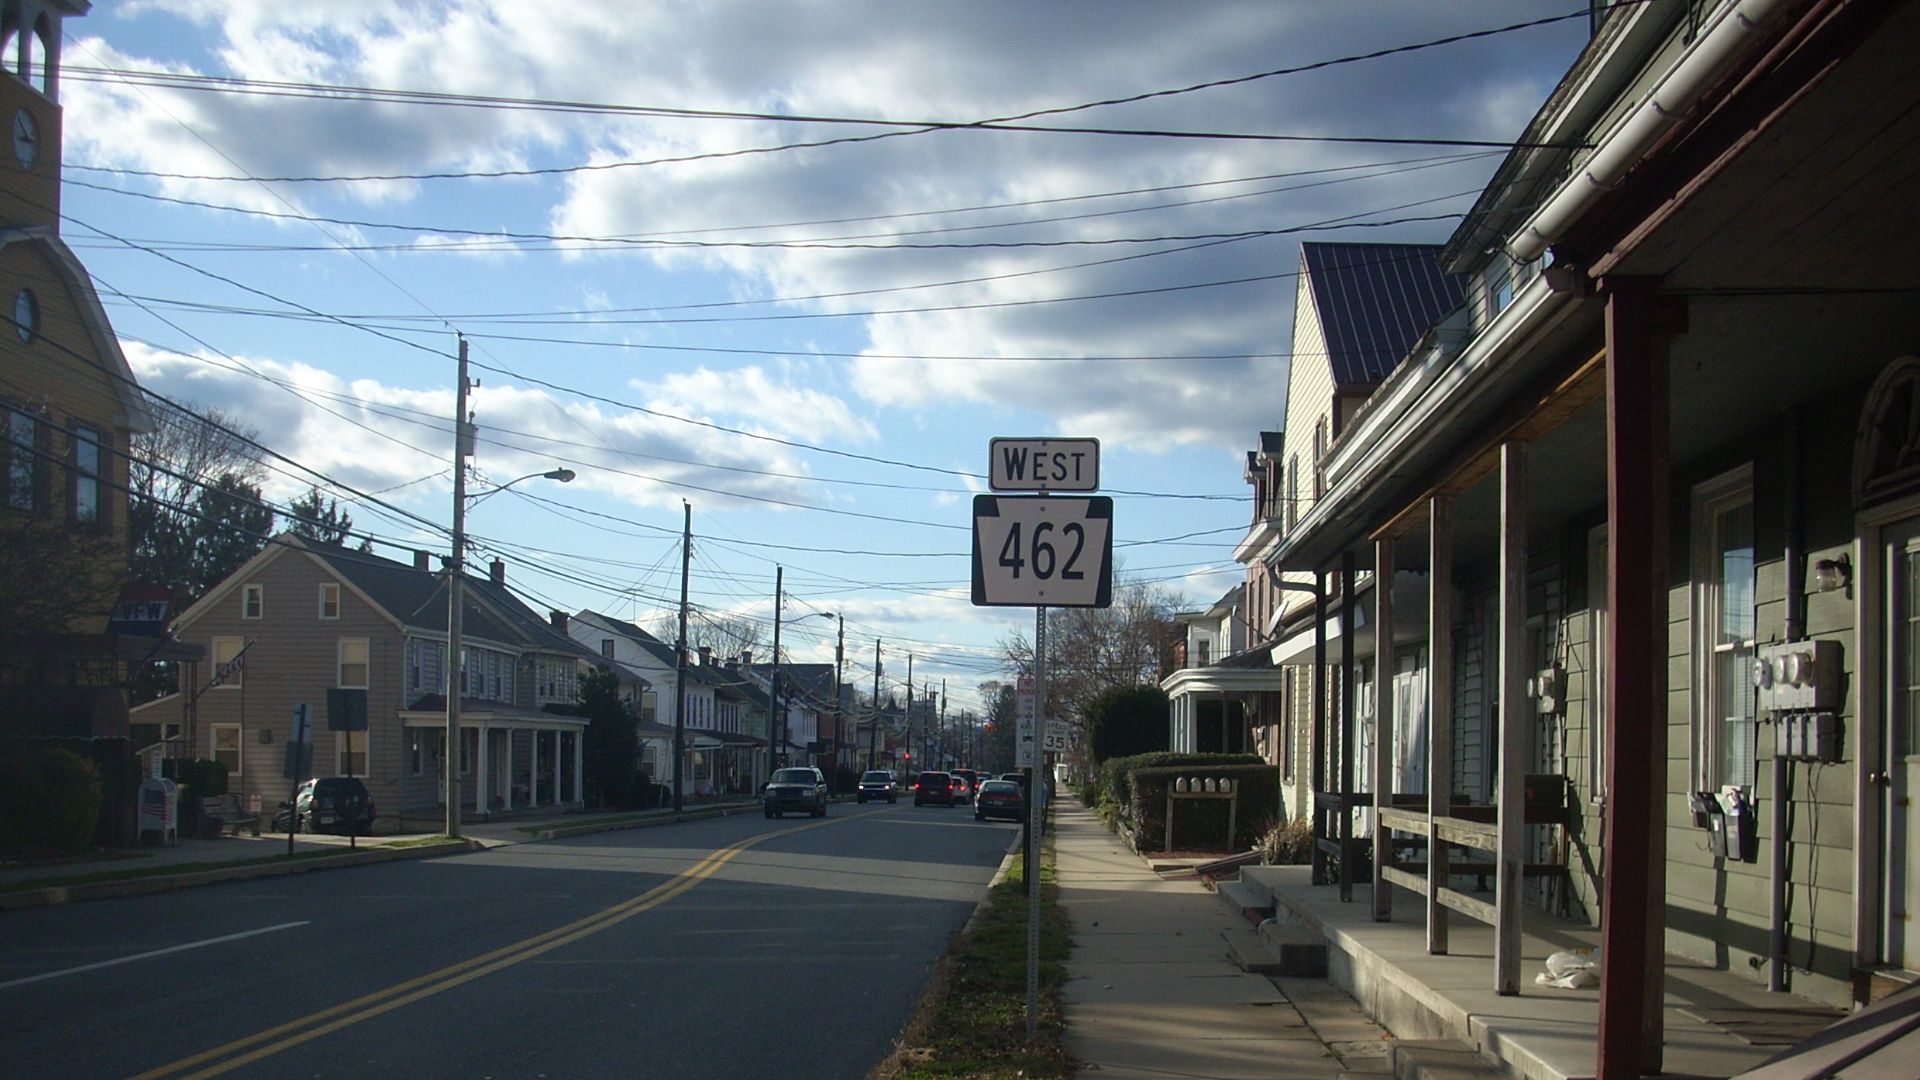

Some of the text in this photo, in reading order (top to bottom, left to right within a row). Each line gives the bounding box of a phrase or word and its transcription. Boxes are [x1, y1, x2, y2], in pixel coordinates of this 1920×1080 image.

[1003, 447, 1085, 481] WEST
[999, 521, 1085, 580] 462
[122, 603, 162, 620] VFW
[1047, 722, 1067, 730] SPEED
[1045, 735, 1065, 748] 35
